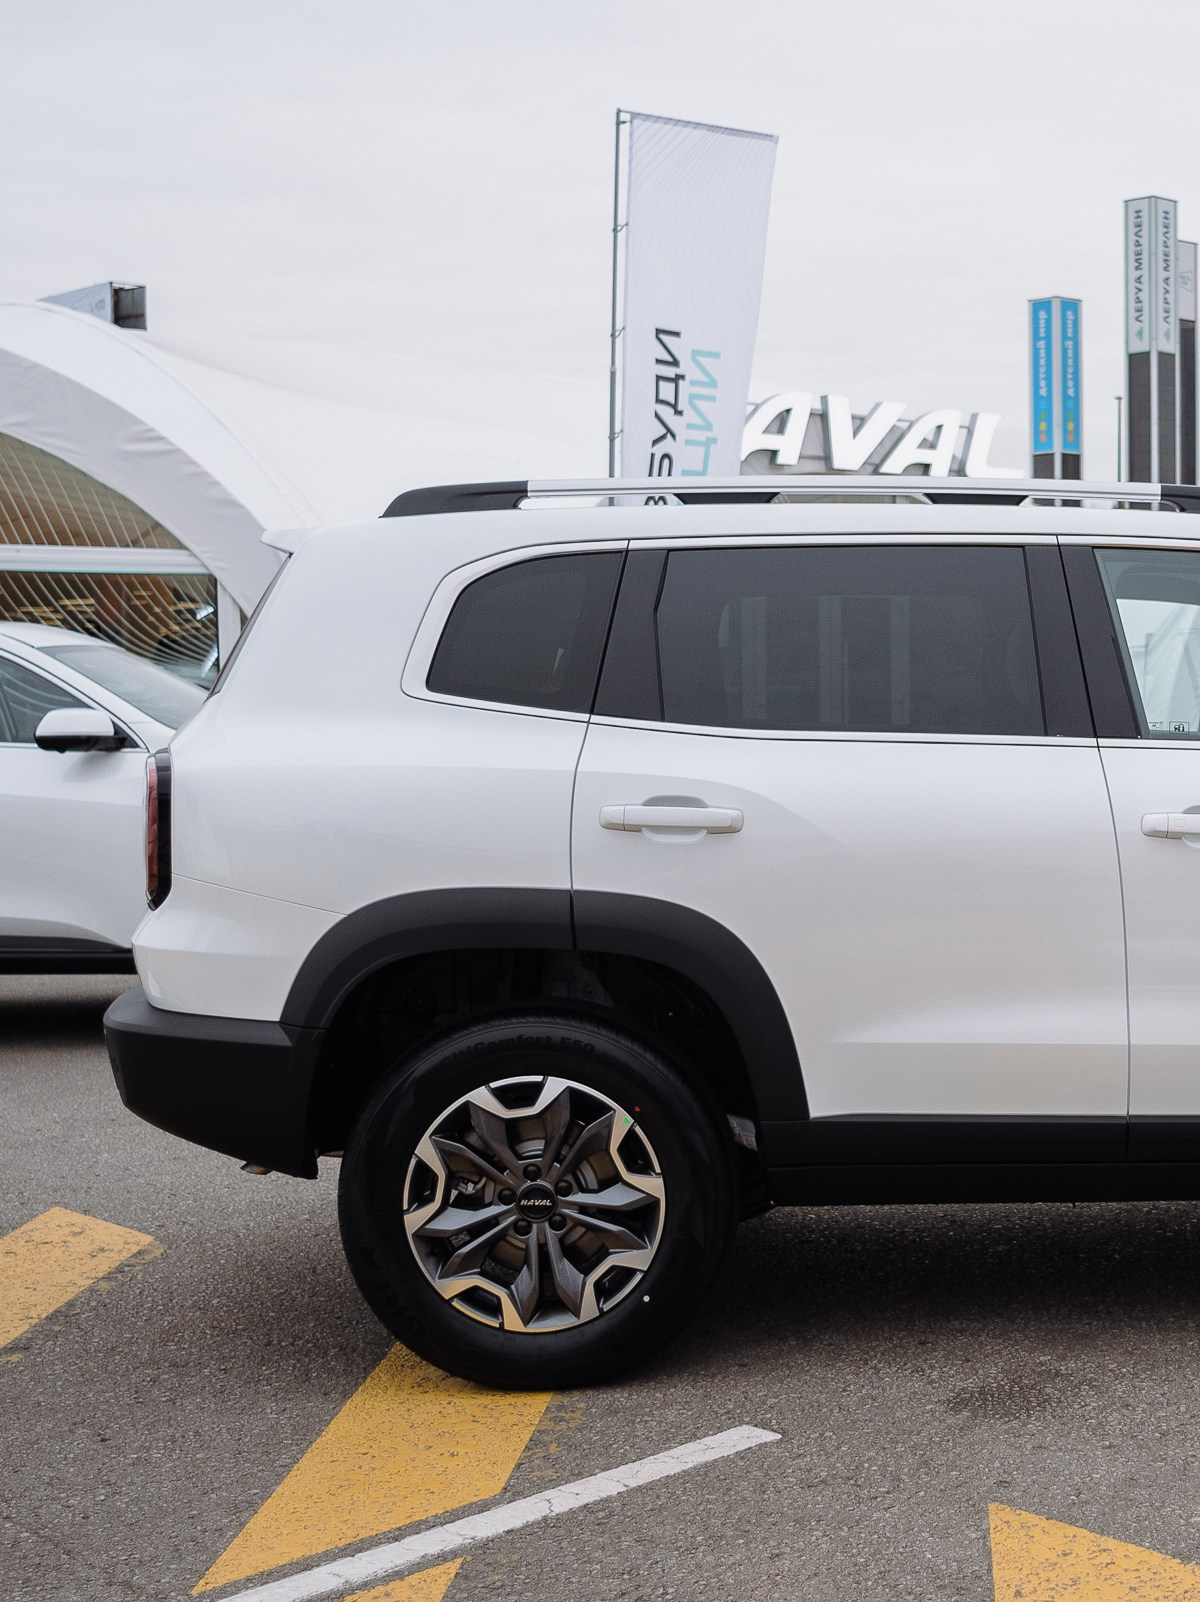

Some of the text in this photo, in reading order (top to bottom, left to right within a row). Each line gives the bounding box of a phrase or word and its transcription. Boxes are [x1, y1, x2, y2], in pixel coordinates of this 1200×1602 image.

[1134, 209, 1144, 323] ЛЕРУА МЕРЛЕН
[1162, 210, 1171, 325] ЛЕРУА МЕРЛЕН
[645, 327, 686, 506] БУДИ
[681, 348, 722, 477] ЦИИ
[740, 391, 1027, 478] AVAL
